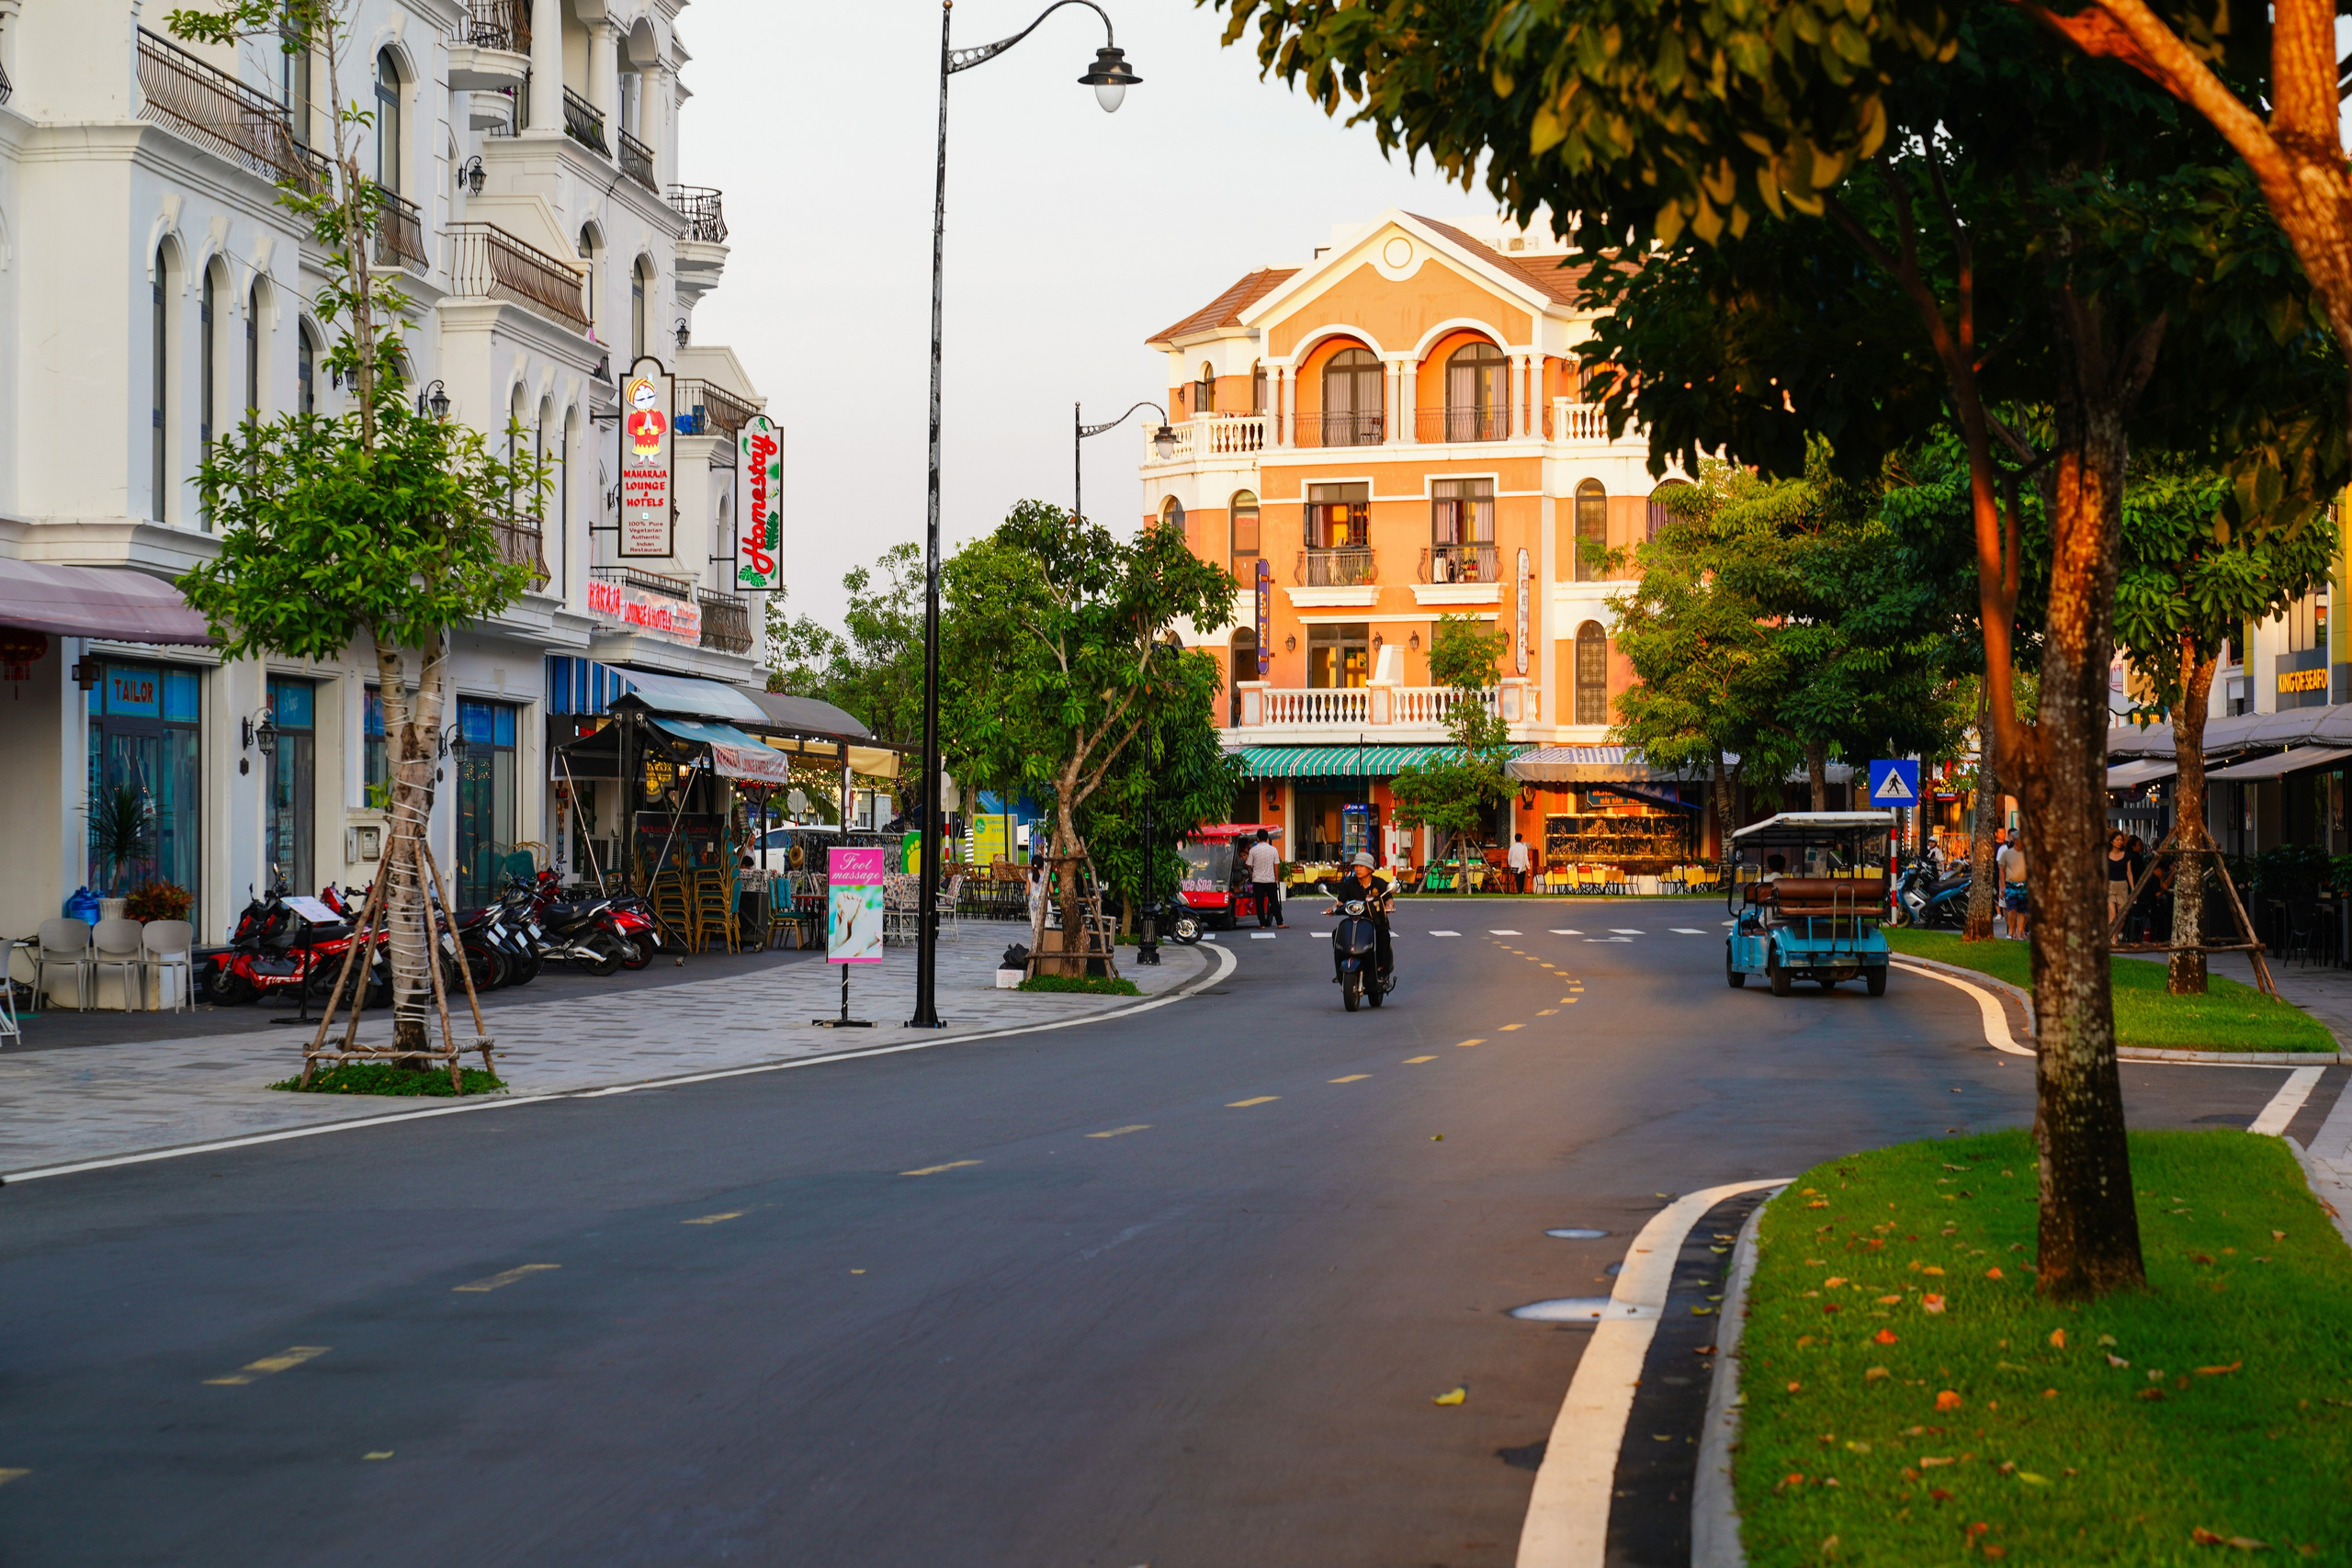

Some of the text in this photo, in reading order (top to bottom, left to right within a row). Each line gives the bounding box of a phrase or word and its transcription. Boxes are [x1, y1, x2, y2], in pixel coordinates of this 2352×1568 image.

[623, 469, 668, 478] MAHARAJA
[626, 481, 665, 491] LOUNGE
[627, 498, 664, 507] HOTELS
[741, 434, 778, 574] Homestay
[624, 601, 647, 626] LOUNGE
[651, 606, 672, 631] HOTELS
[2278, 668, 2328, 694] KING OF SEAFO
[115, 678, 153, 704] TAILOR
[840, 852, 873, 870] Foot
[831, 871, 880, 886] massage
[1196, 878, 1212, 892] Spa
